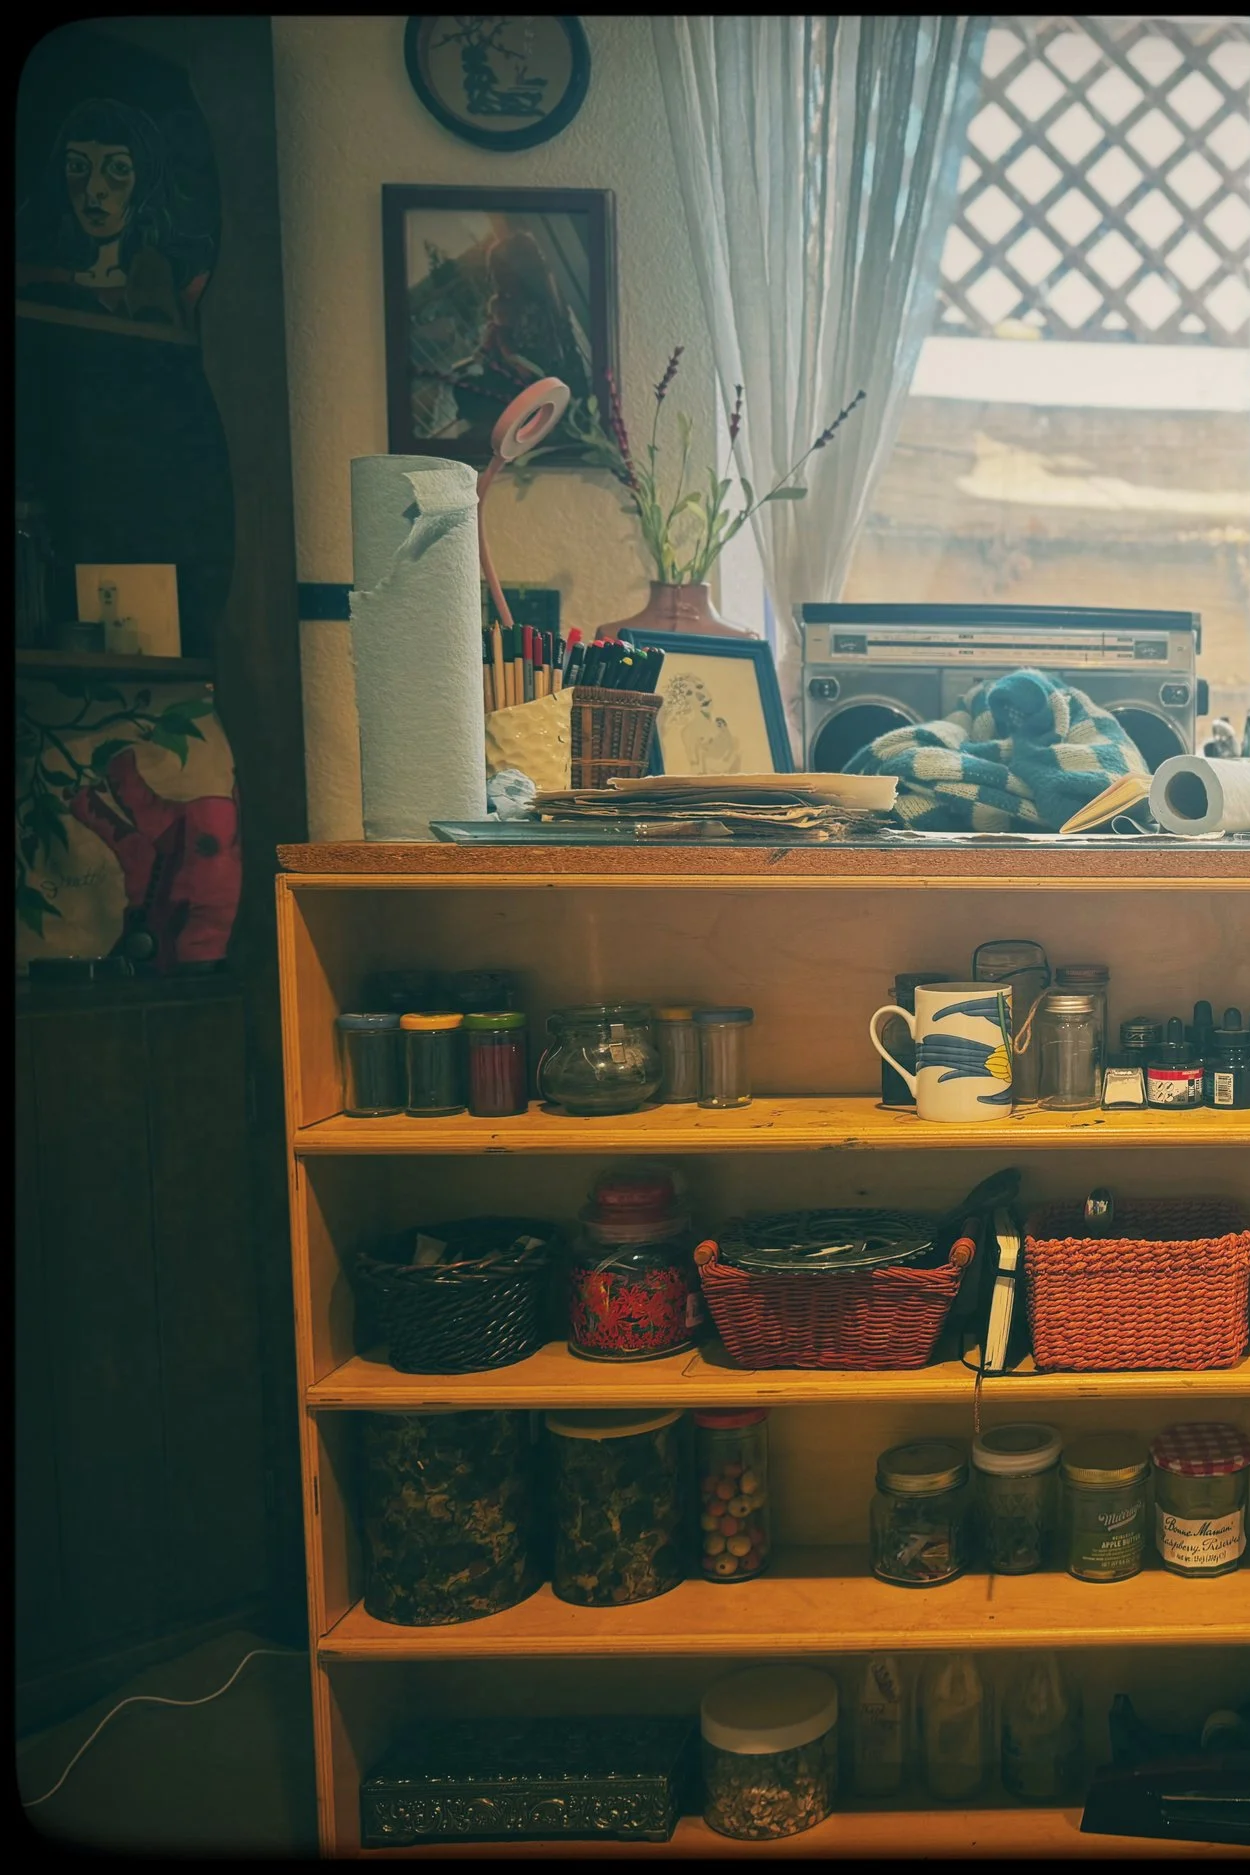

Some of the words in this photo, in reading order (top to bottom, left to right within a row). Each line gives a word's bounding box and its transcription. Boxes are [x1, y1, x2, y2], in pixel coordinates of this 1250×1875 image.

[1164, 1516, 1193, 1537] Bonne
[1193, 1521, 1232, 1537] Maman
[1101, 1540, 1121, 1549] APPLE
